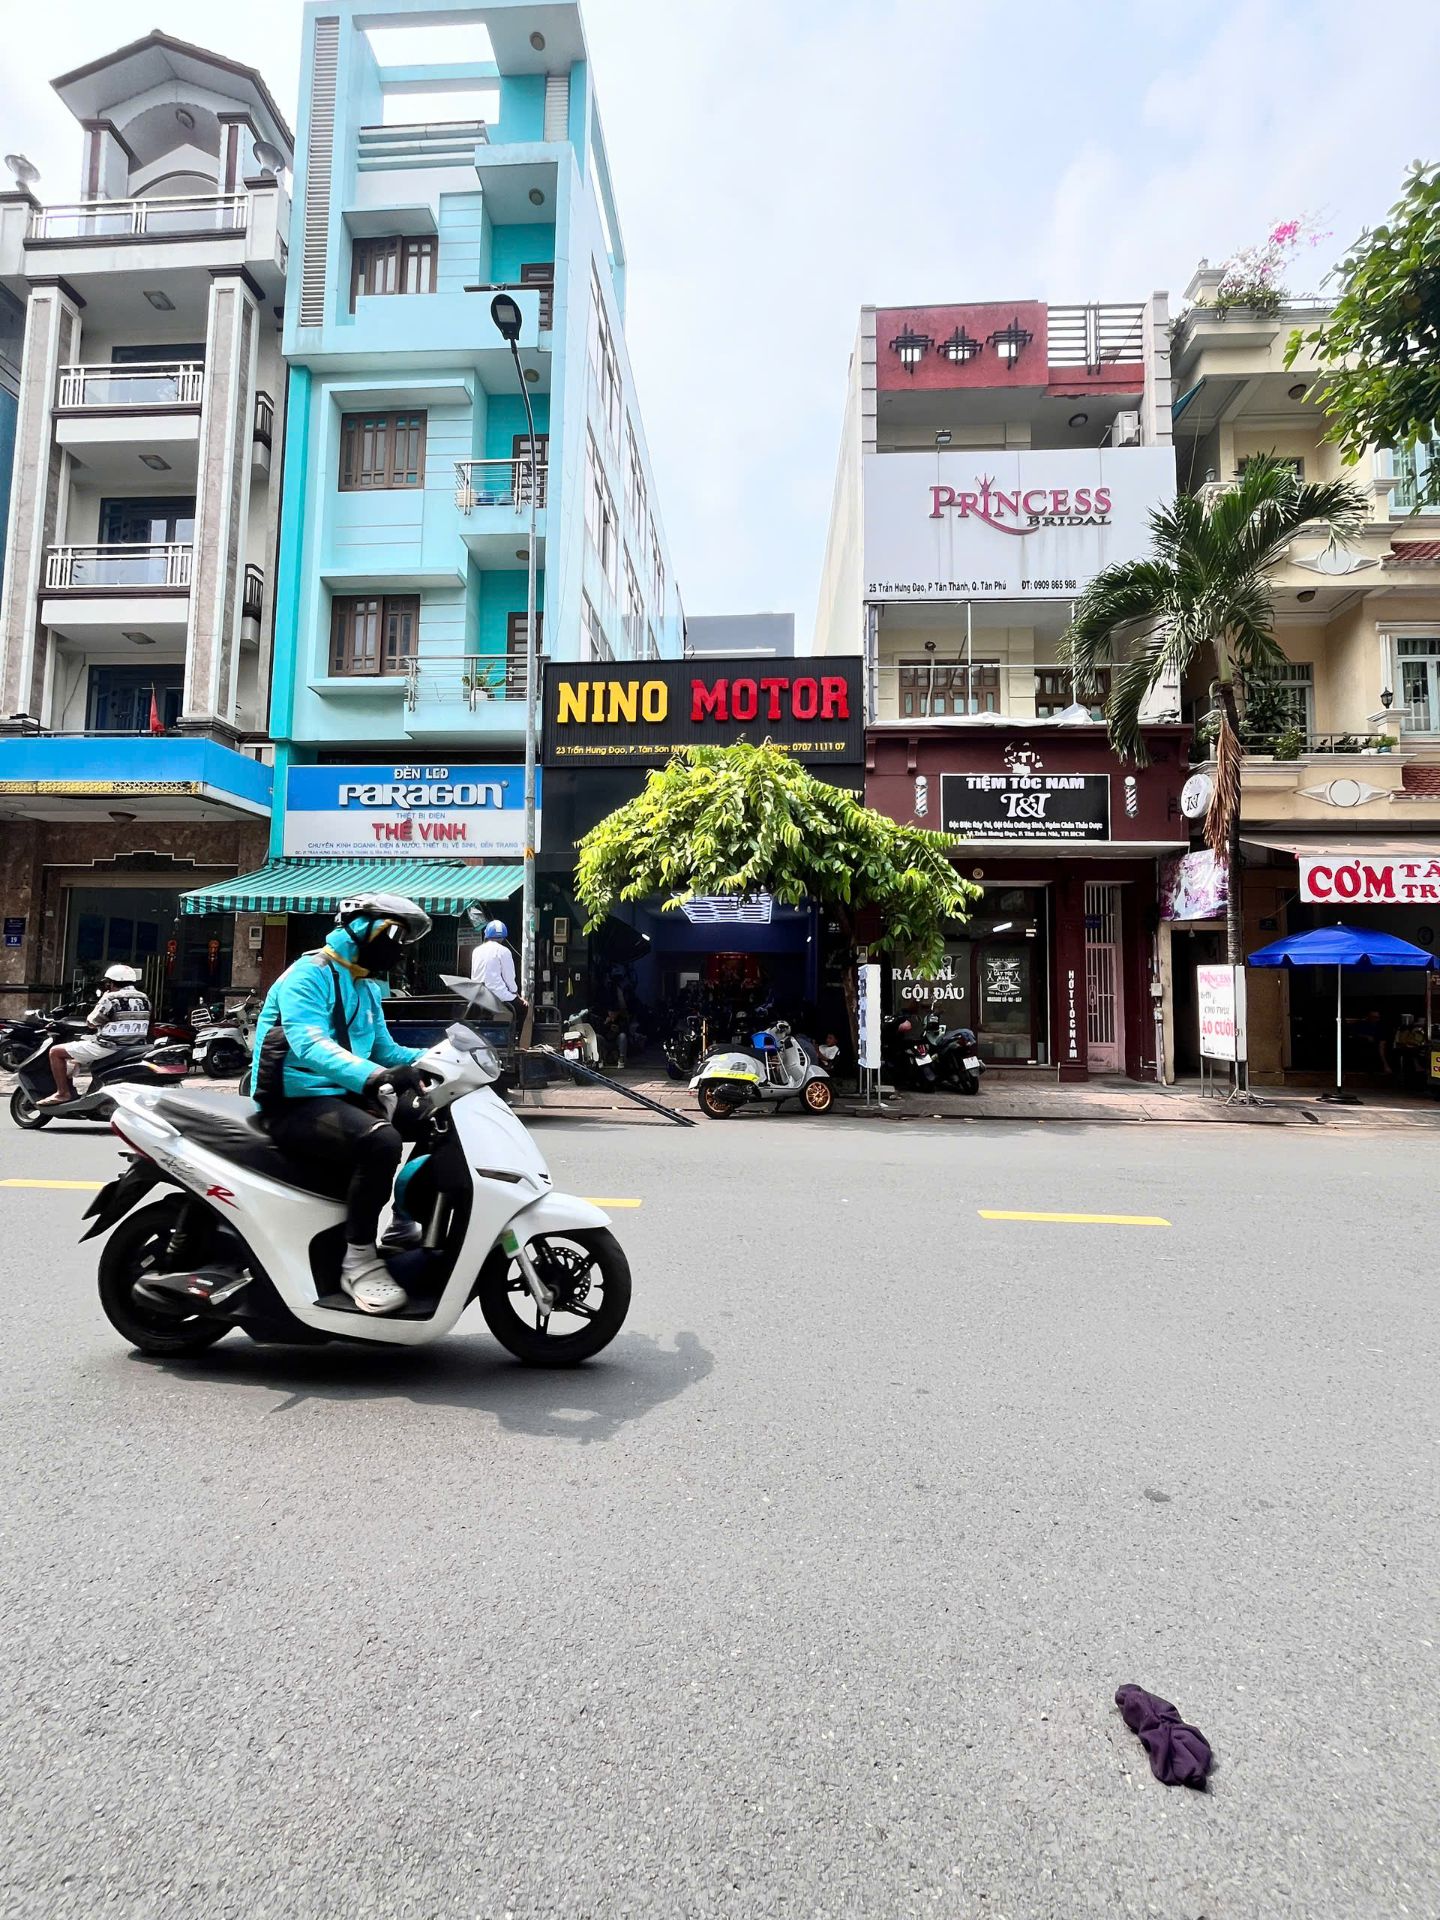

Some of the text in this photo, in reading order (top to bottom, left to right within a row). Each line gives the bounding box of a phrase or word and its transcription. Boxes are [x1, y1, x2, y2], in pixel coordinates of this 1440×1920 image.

[929, 482, 1112, 524] PRINCESS
[1027, 515, 1112, 527] BRIDAL
[869, 583, 876, 592] 25
[1034, 580, 1050, 589] 0909
[557, 676, 849, 722] NINO MOTOR
[556, 746, 566, 755] 23
[792, 742, 812, 751] 0707
[815, 742, 833, 751] 1111
[835, 742, 846, 751] 07
[425, 767, 449, 780] LED
[966, 774, 1085, 792] TIỆM TÓC NAM
[1000, 793, 1051, 818] T&T
[371, 818, 467, 841] THẾ VINH
[1307, 860, 1396, 898] CƠM
[901, 982, 965, 1002] GỘI ĐẦU
